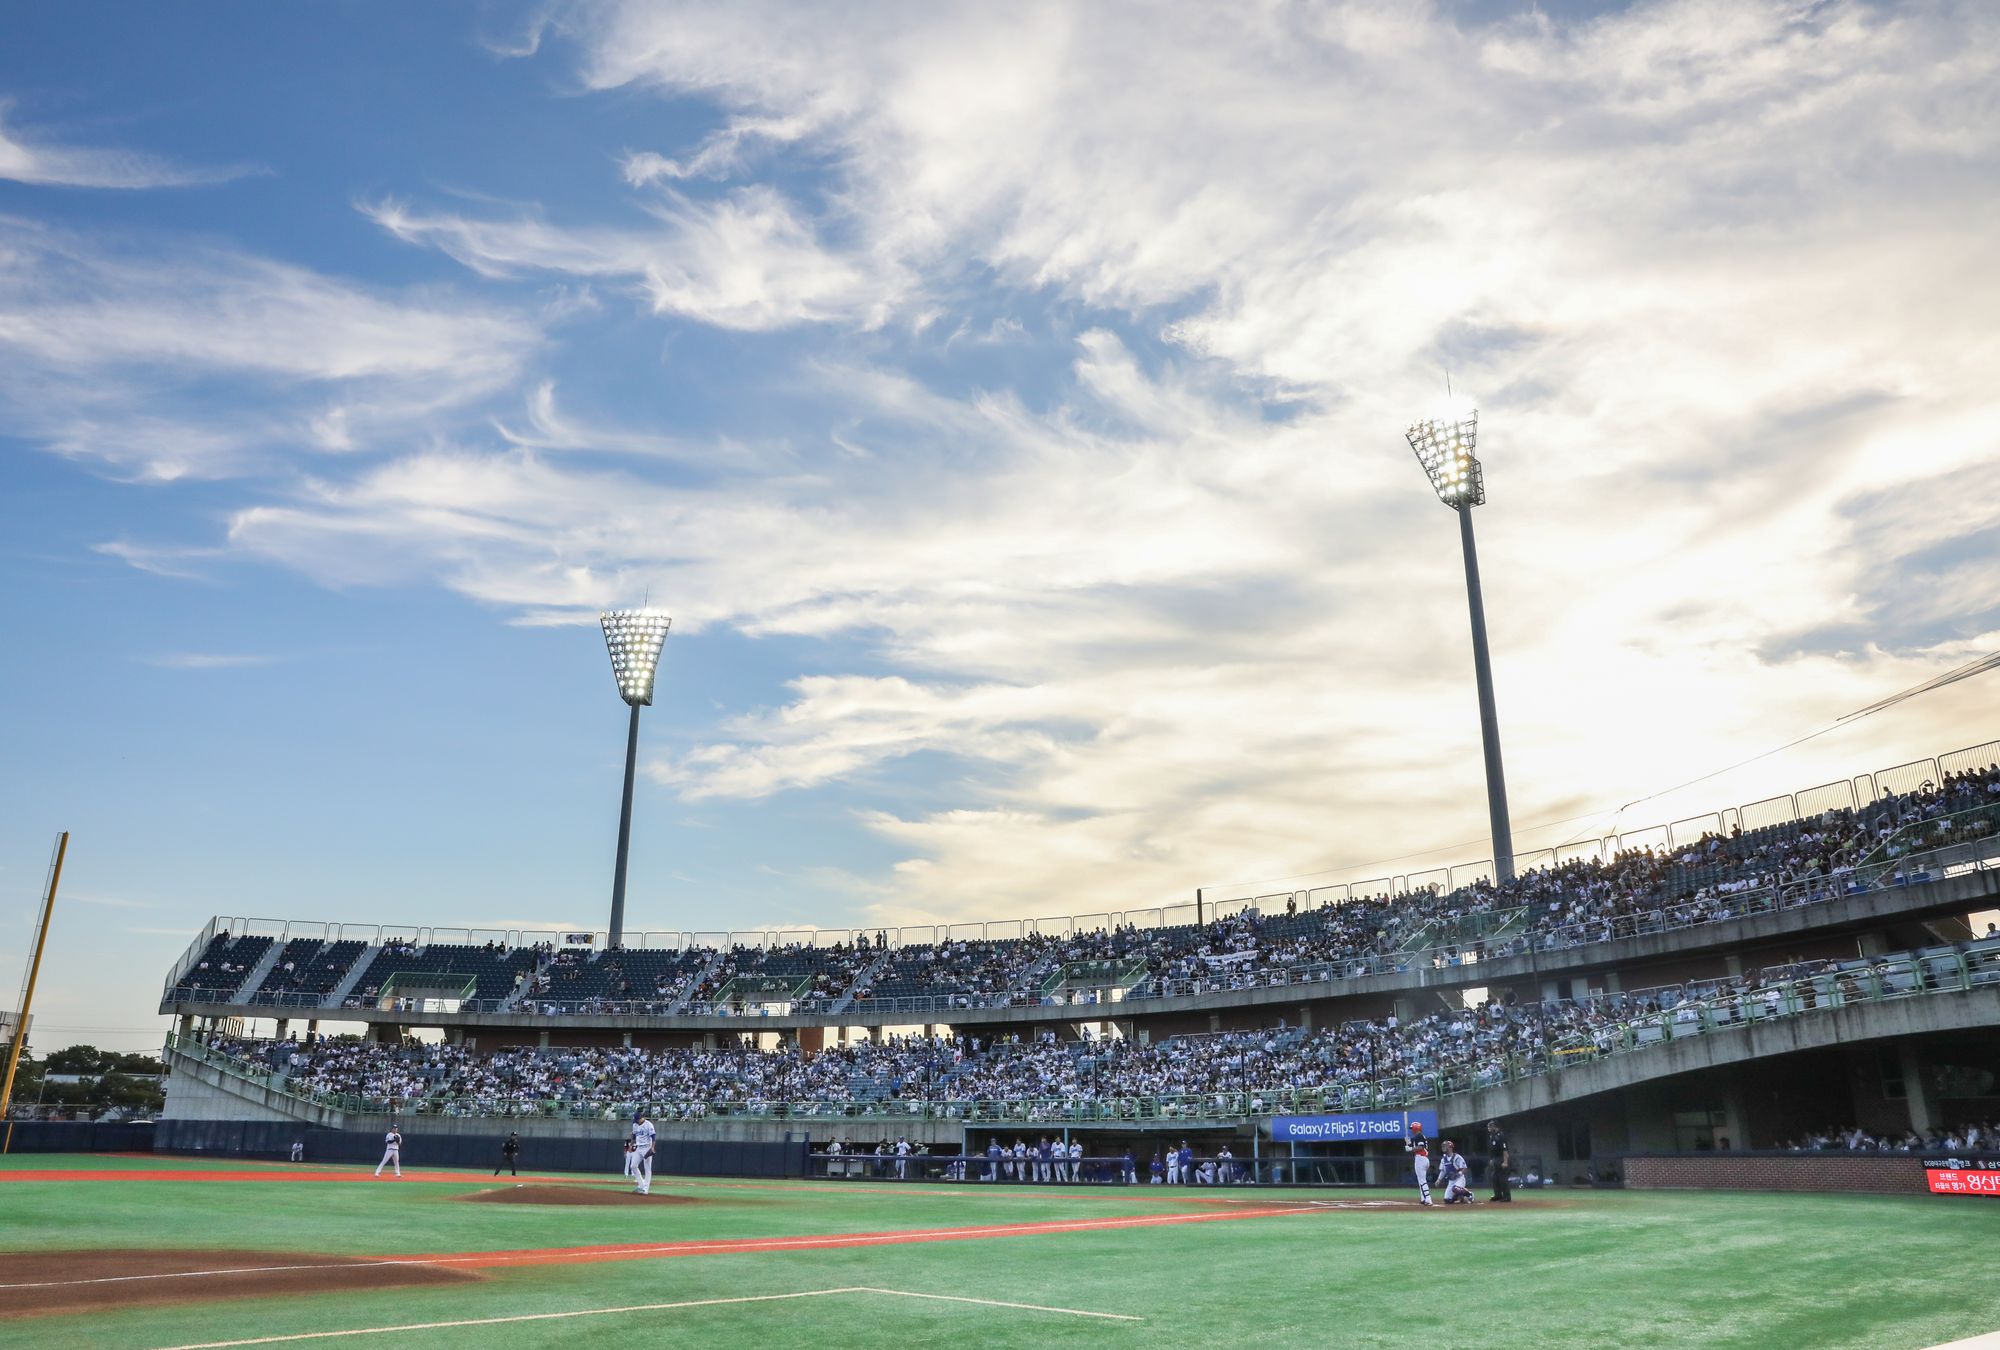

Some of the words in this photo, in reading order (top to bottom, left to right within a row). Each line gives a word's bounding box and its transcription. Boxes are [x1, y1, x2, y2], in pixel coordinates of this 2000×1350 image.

[1289, 1124, 1323, 1137] Galaxy
[1324, 1123, 1330, 1134] Z
[1331, 1121, 1355, 1137] Flip5
[1360, 1121, 1366, 1133] Z
[1368, 1120, 1400, 1133] Fold5
